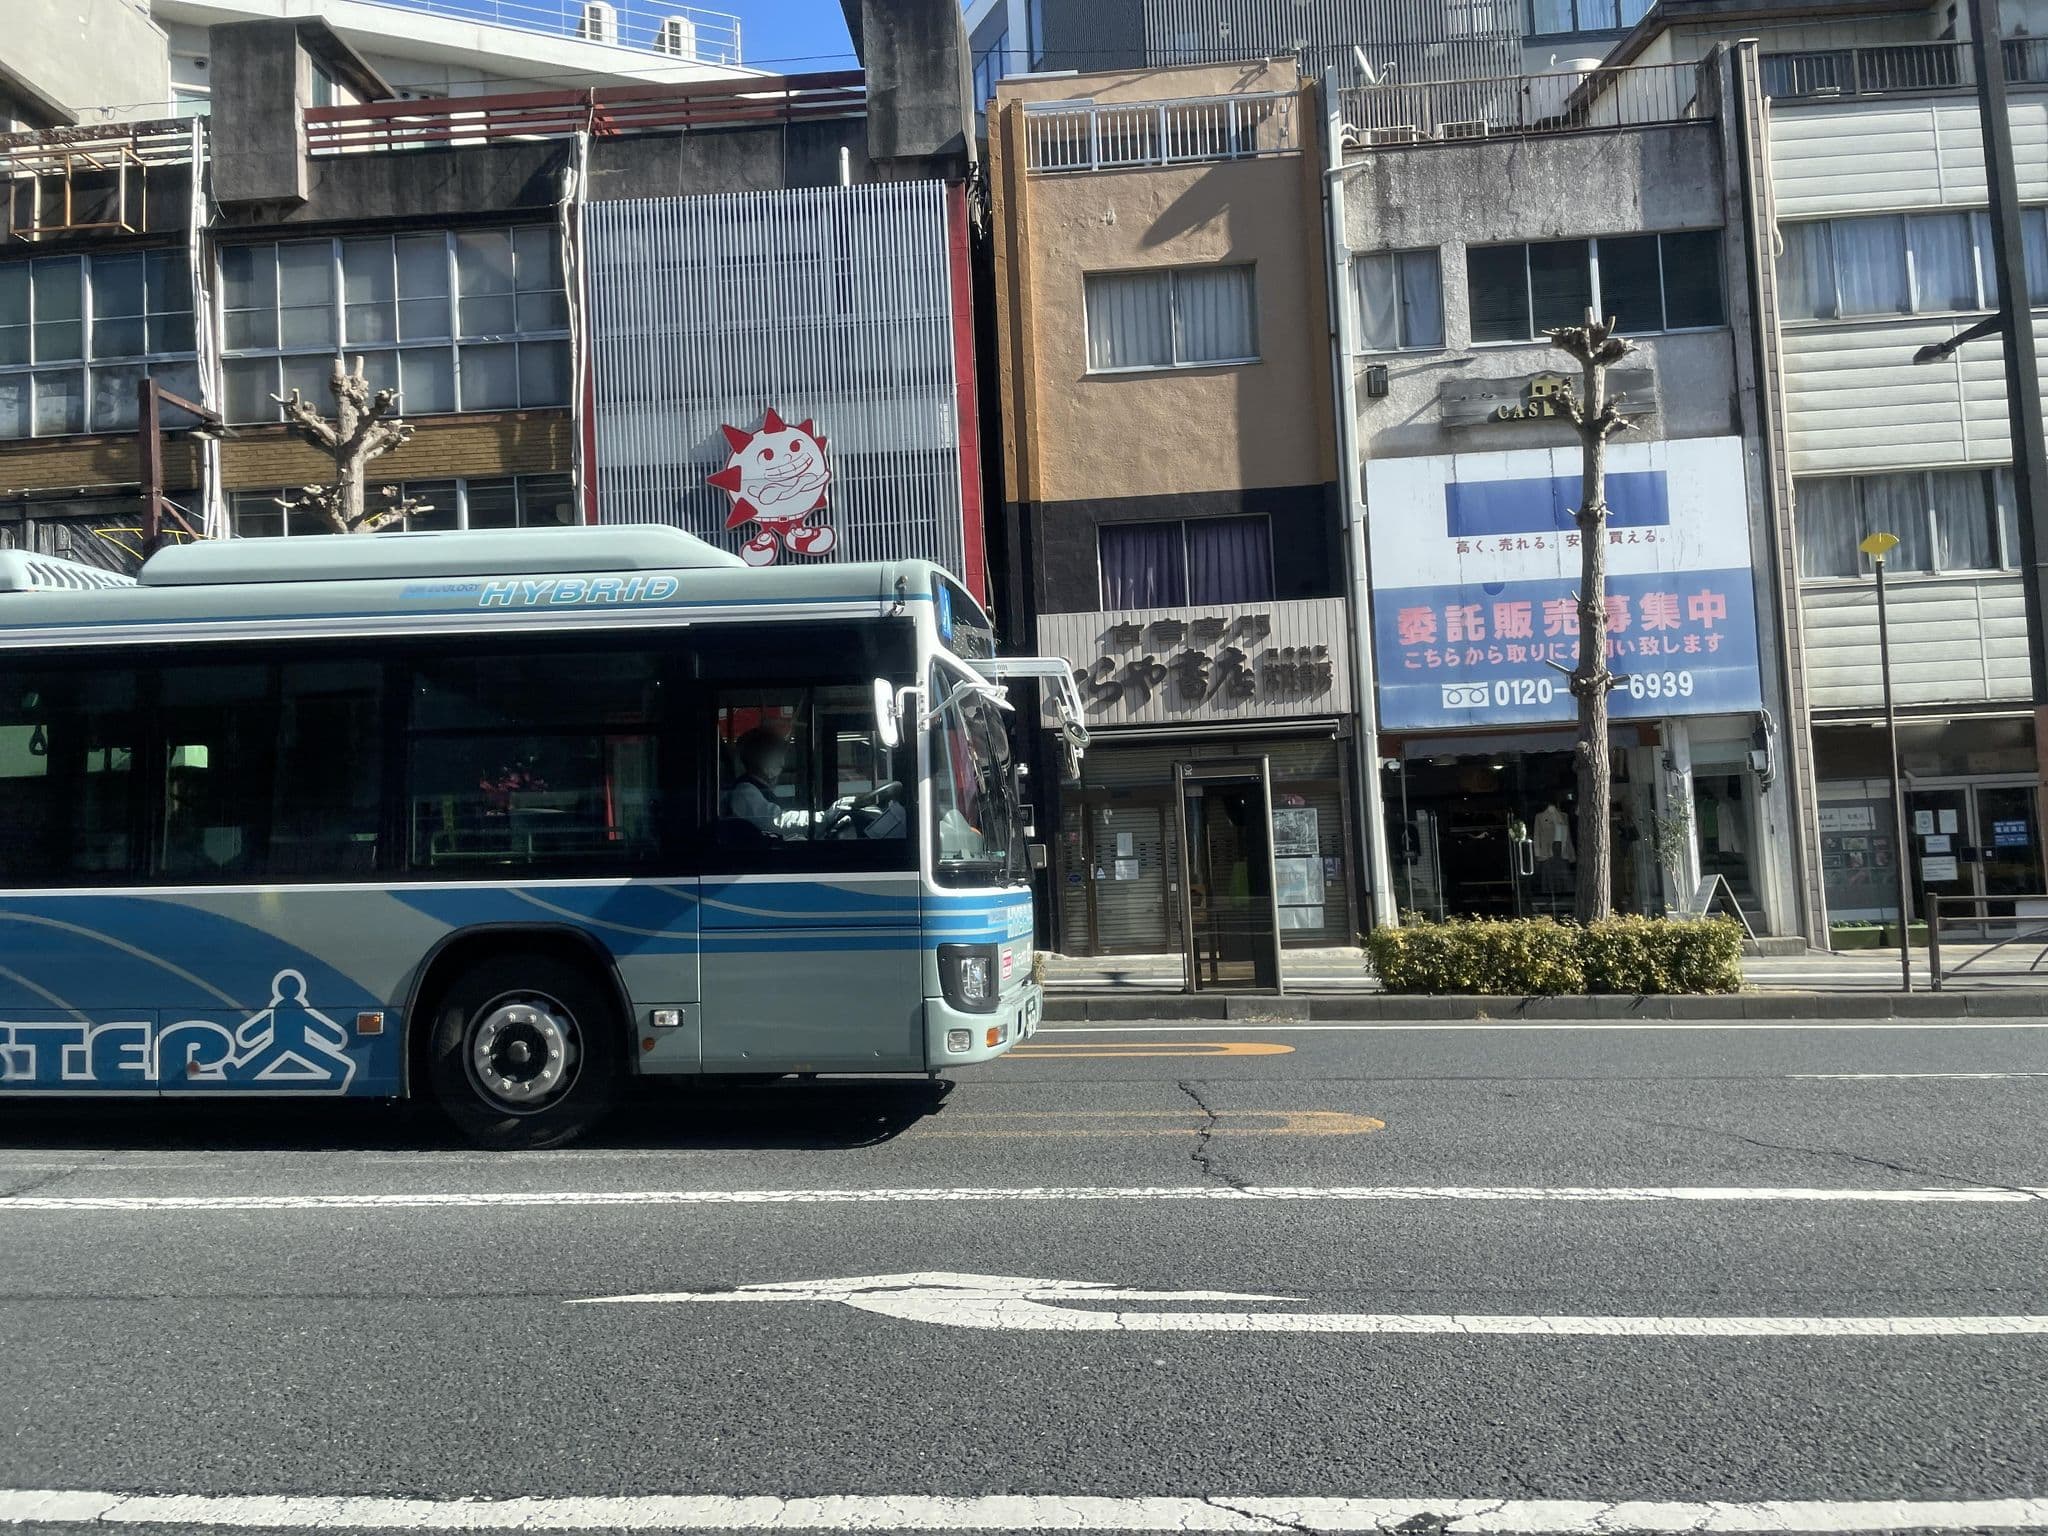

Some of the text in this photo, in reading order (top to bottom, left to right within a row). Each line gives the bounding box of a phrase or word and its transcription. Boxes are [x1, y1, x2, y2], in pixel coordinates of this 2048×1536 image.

[1455, 530, 1666, 554] 高く、売れる。安買える。
[479, 576, 679, 606] HYBRID
[1397, 589, 1728, 645] 委託販売募集中
